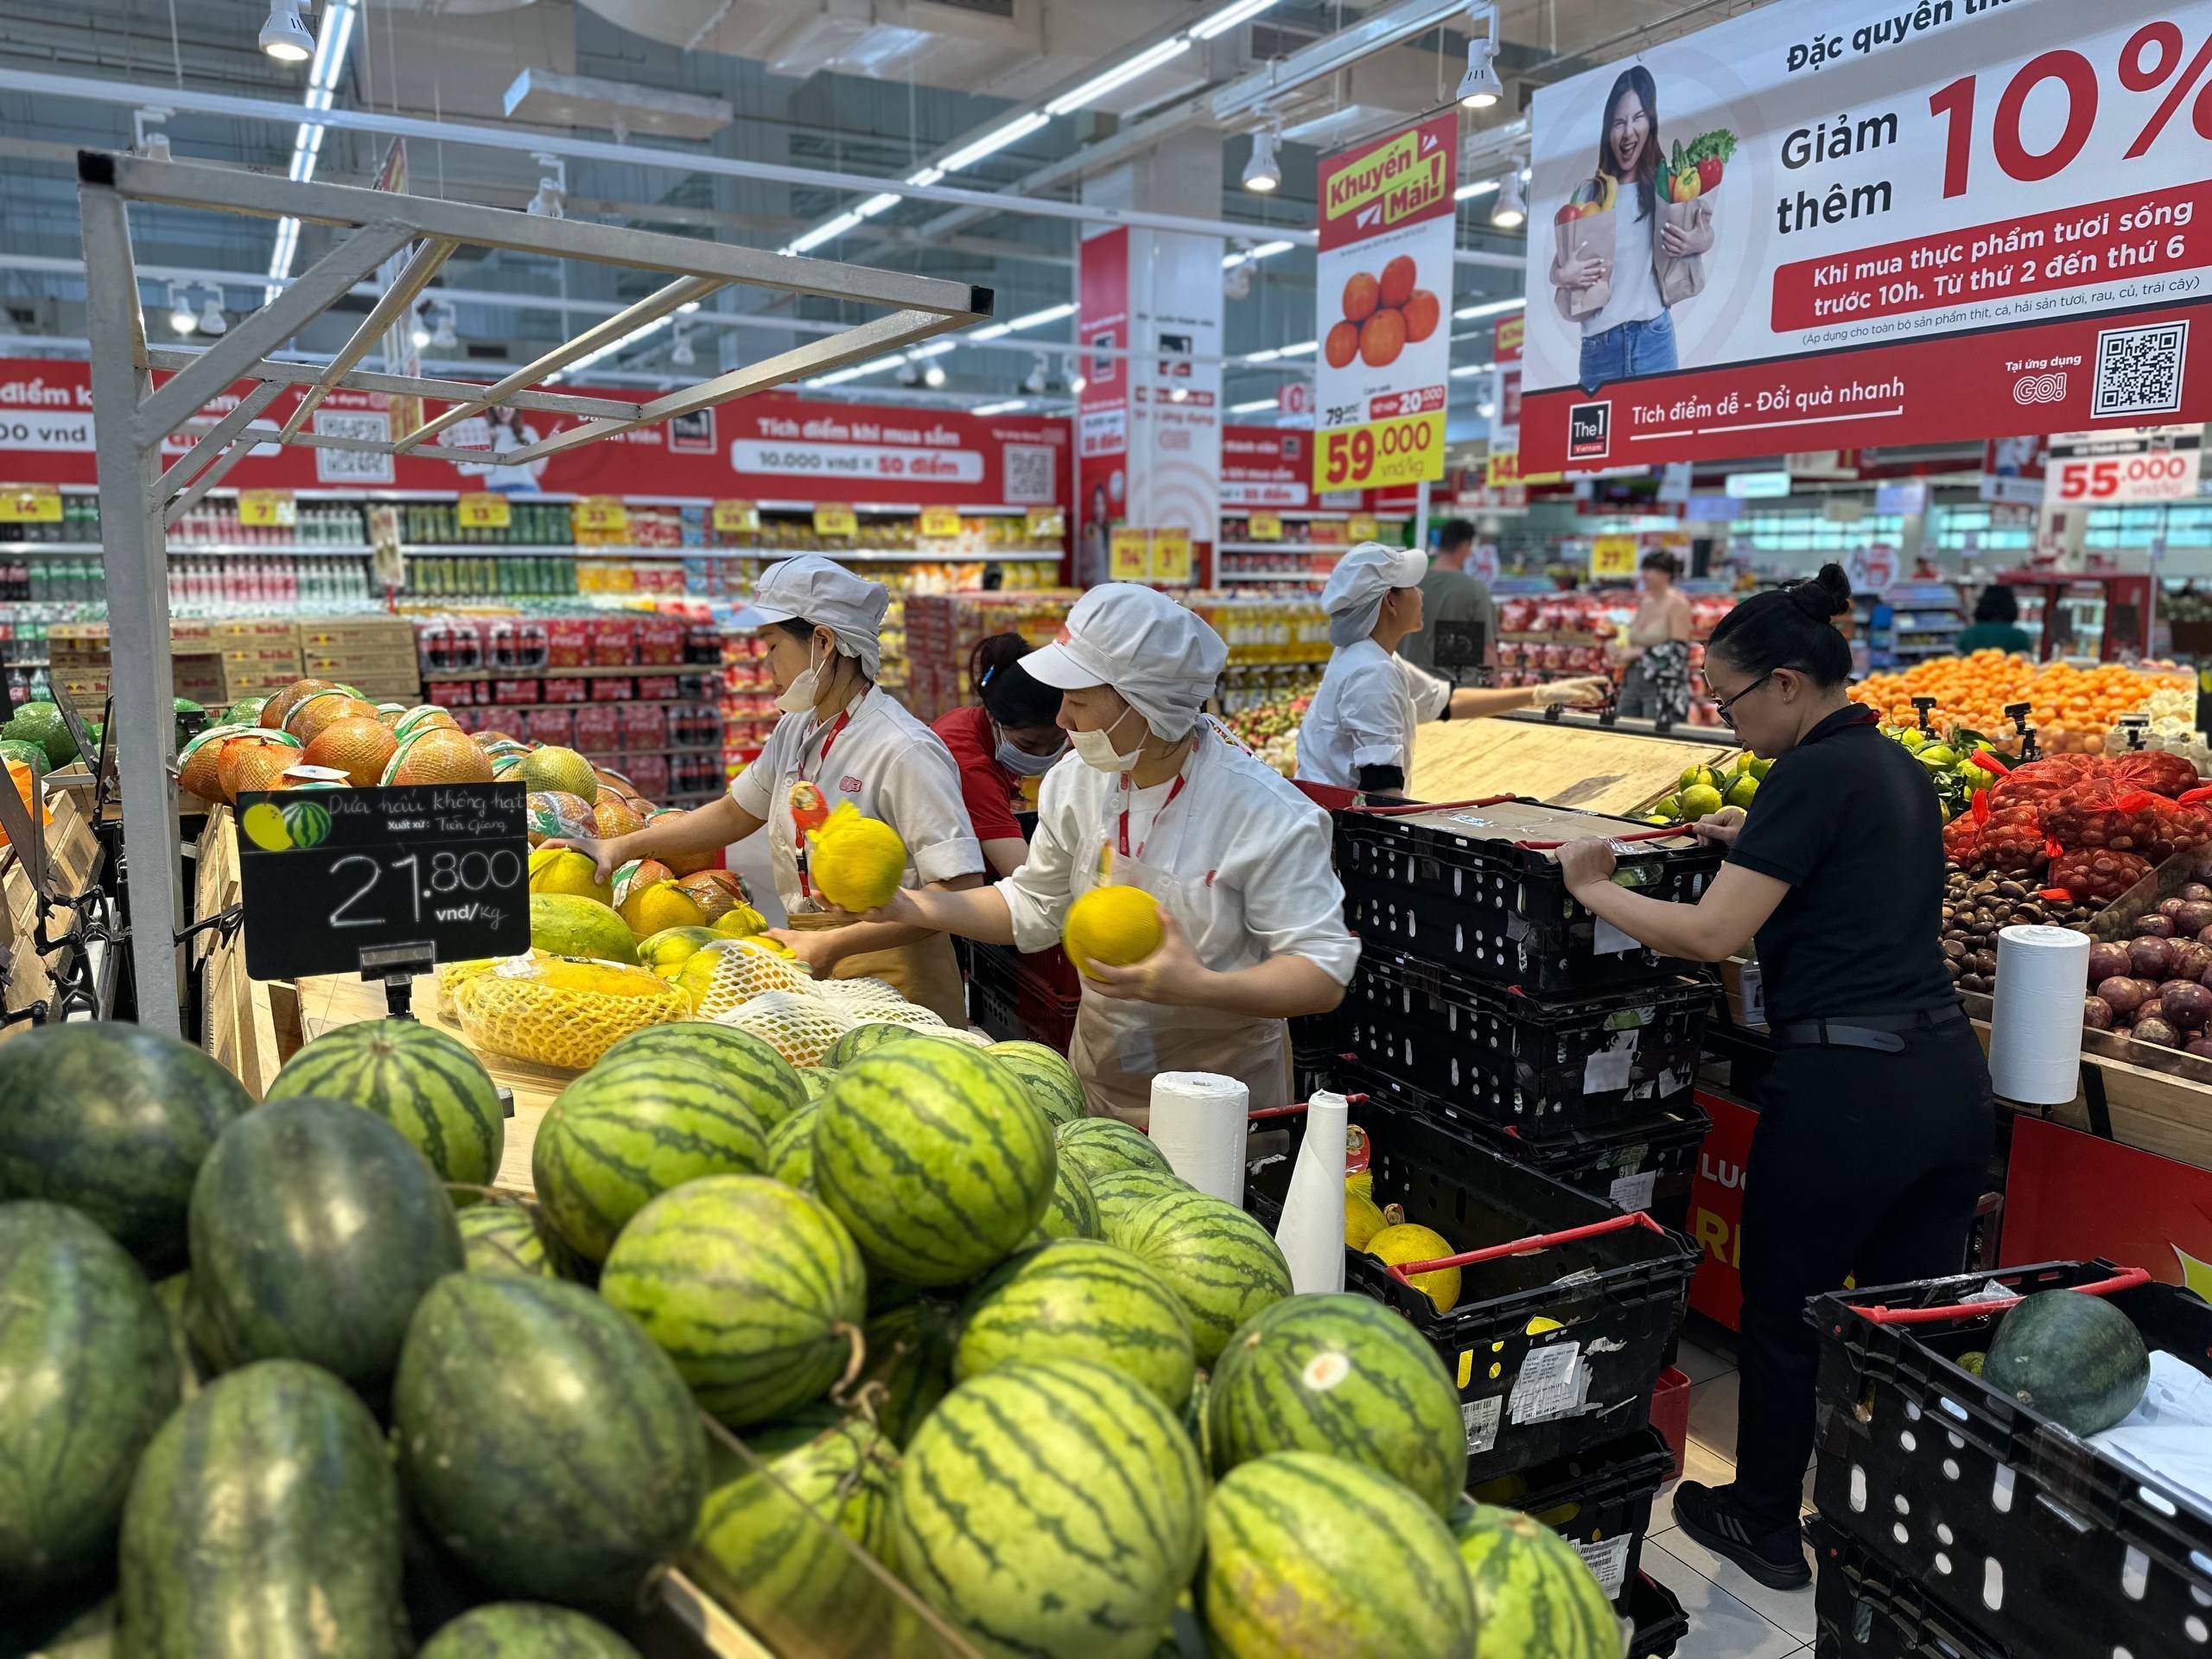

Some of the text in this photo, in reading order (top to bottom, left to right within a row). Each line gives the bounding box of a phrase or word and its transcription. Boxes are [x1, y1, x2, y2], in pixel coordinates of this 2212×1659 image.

[1787, 34, 1843, 72] Đặc
[1929, 21, 2212, 199] 10%
[1781, 113, 1897, 169] Giảm
[1777, 181, 1891, 234] thêm
[1814, 200, 2193, 287] Khi mua thực phẩm tươi sống
[1815, 235, 2184, 316] trước 10h. Từ thứ 2 đến thứ 6
[1823, 329, 1847, 342] dụng
[1851, 327, 1869, 337] cho
[1872, 323, 1894, 334] toàn
[1897, 320, 1910, 330] bộ
[1914, 316, 1932, 327] sản
[1936, 310, 1967, 326] phẩm
[2015, 300, 2032, 314] hải
[2036, 297, 2056, 310] sản
[2142, 281, 2164, 296] trái
[2005, 355, 2082, 372] Tại ứng dụng
[1632, 404, 1665, 424] Tích
[1669, 395, 1712, 423] điểm
[1717, 391, 1738, 416] dễ
[1757, 385, 1789, 411] Đổi
[1796, 385, 1832, 411] quà
[1840, 377, 1904, 403] nhanh
[1325, 421, 1432, 485] 59.000
[2060, 457, 2186, 499] 55.000
[388, 819, 410, 830] Xuất
[434, 788, 487, 817] không
[491, 788, 525, 813] hạt
